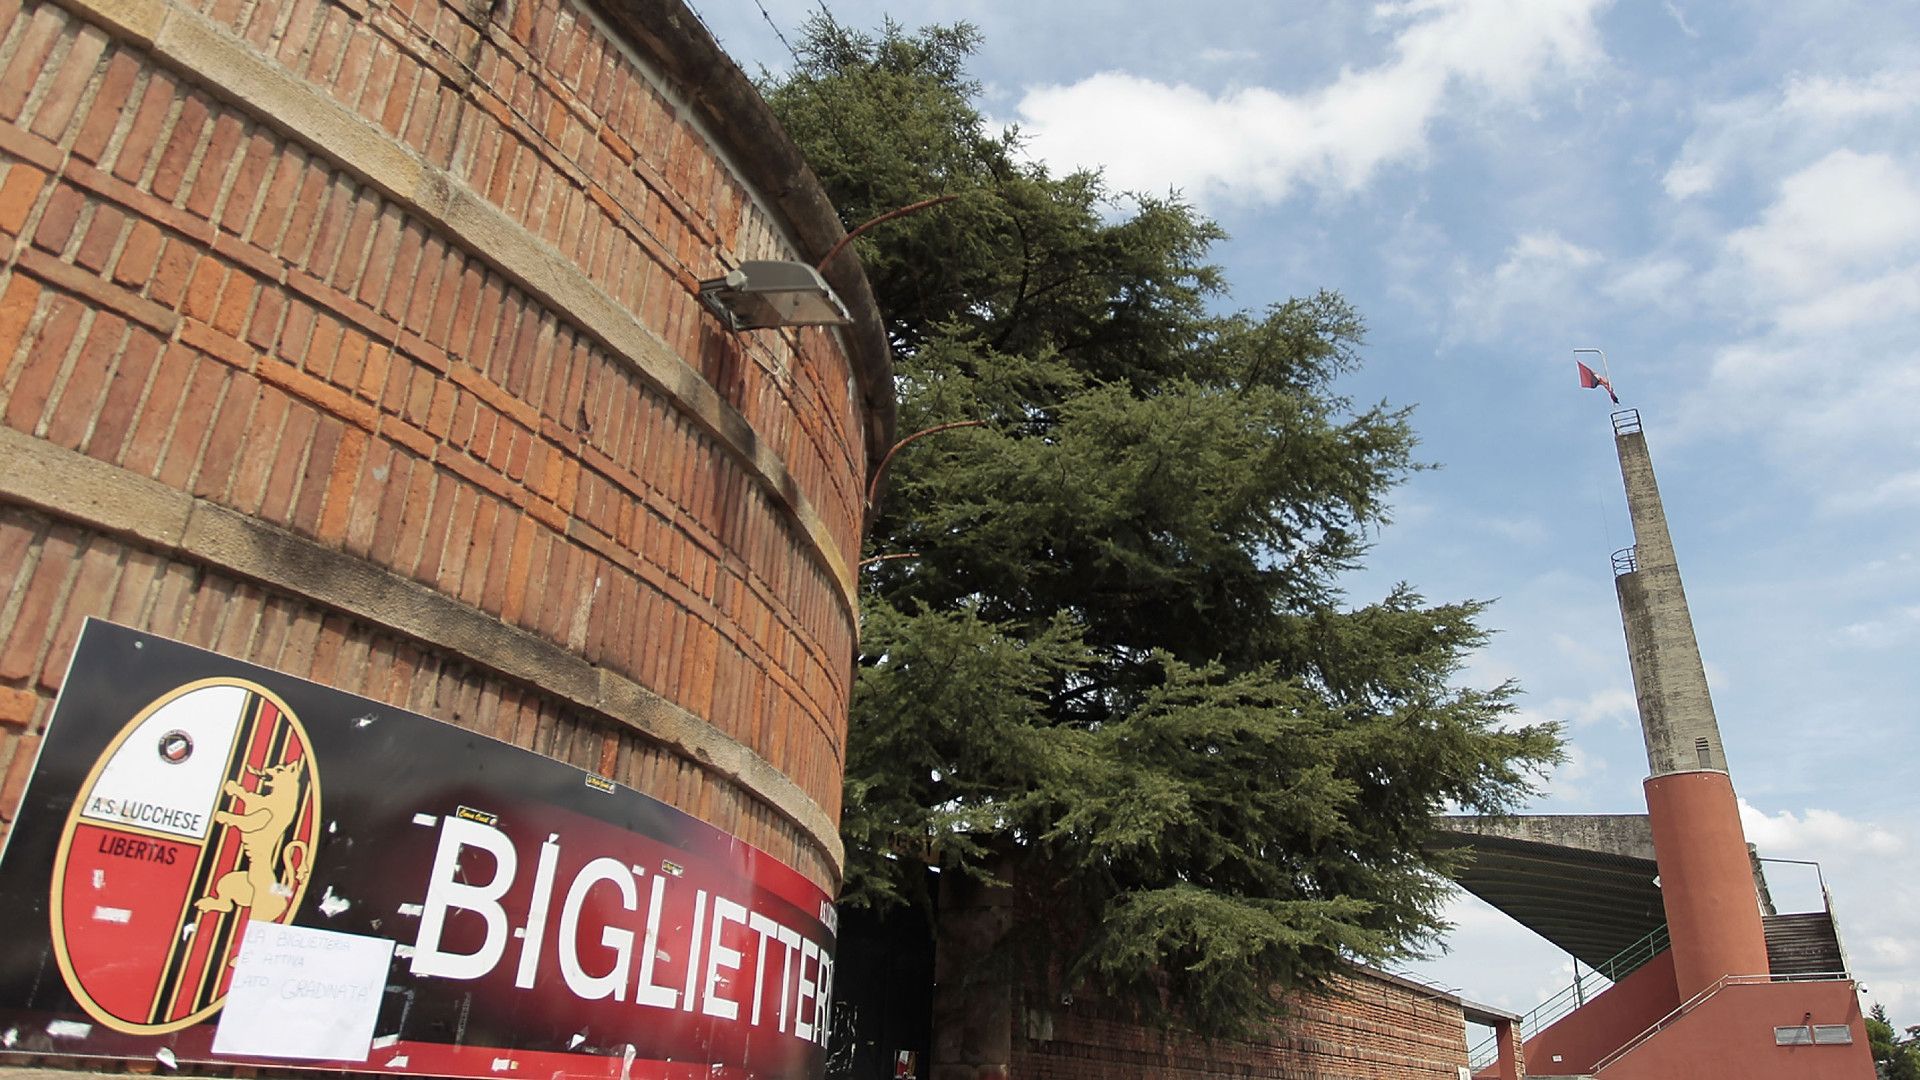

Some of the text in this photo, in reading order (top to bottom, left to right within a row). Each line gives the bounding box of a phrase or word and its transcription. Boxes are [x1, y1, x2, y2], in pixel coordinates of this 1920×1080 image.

[91, 797, 202, 831] A.S. LUCCHESE
[98, 834, 178, 865] LIBERTAS
[247, 928, 265, 944] LA
[232, 975, 270, 989] LATO
